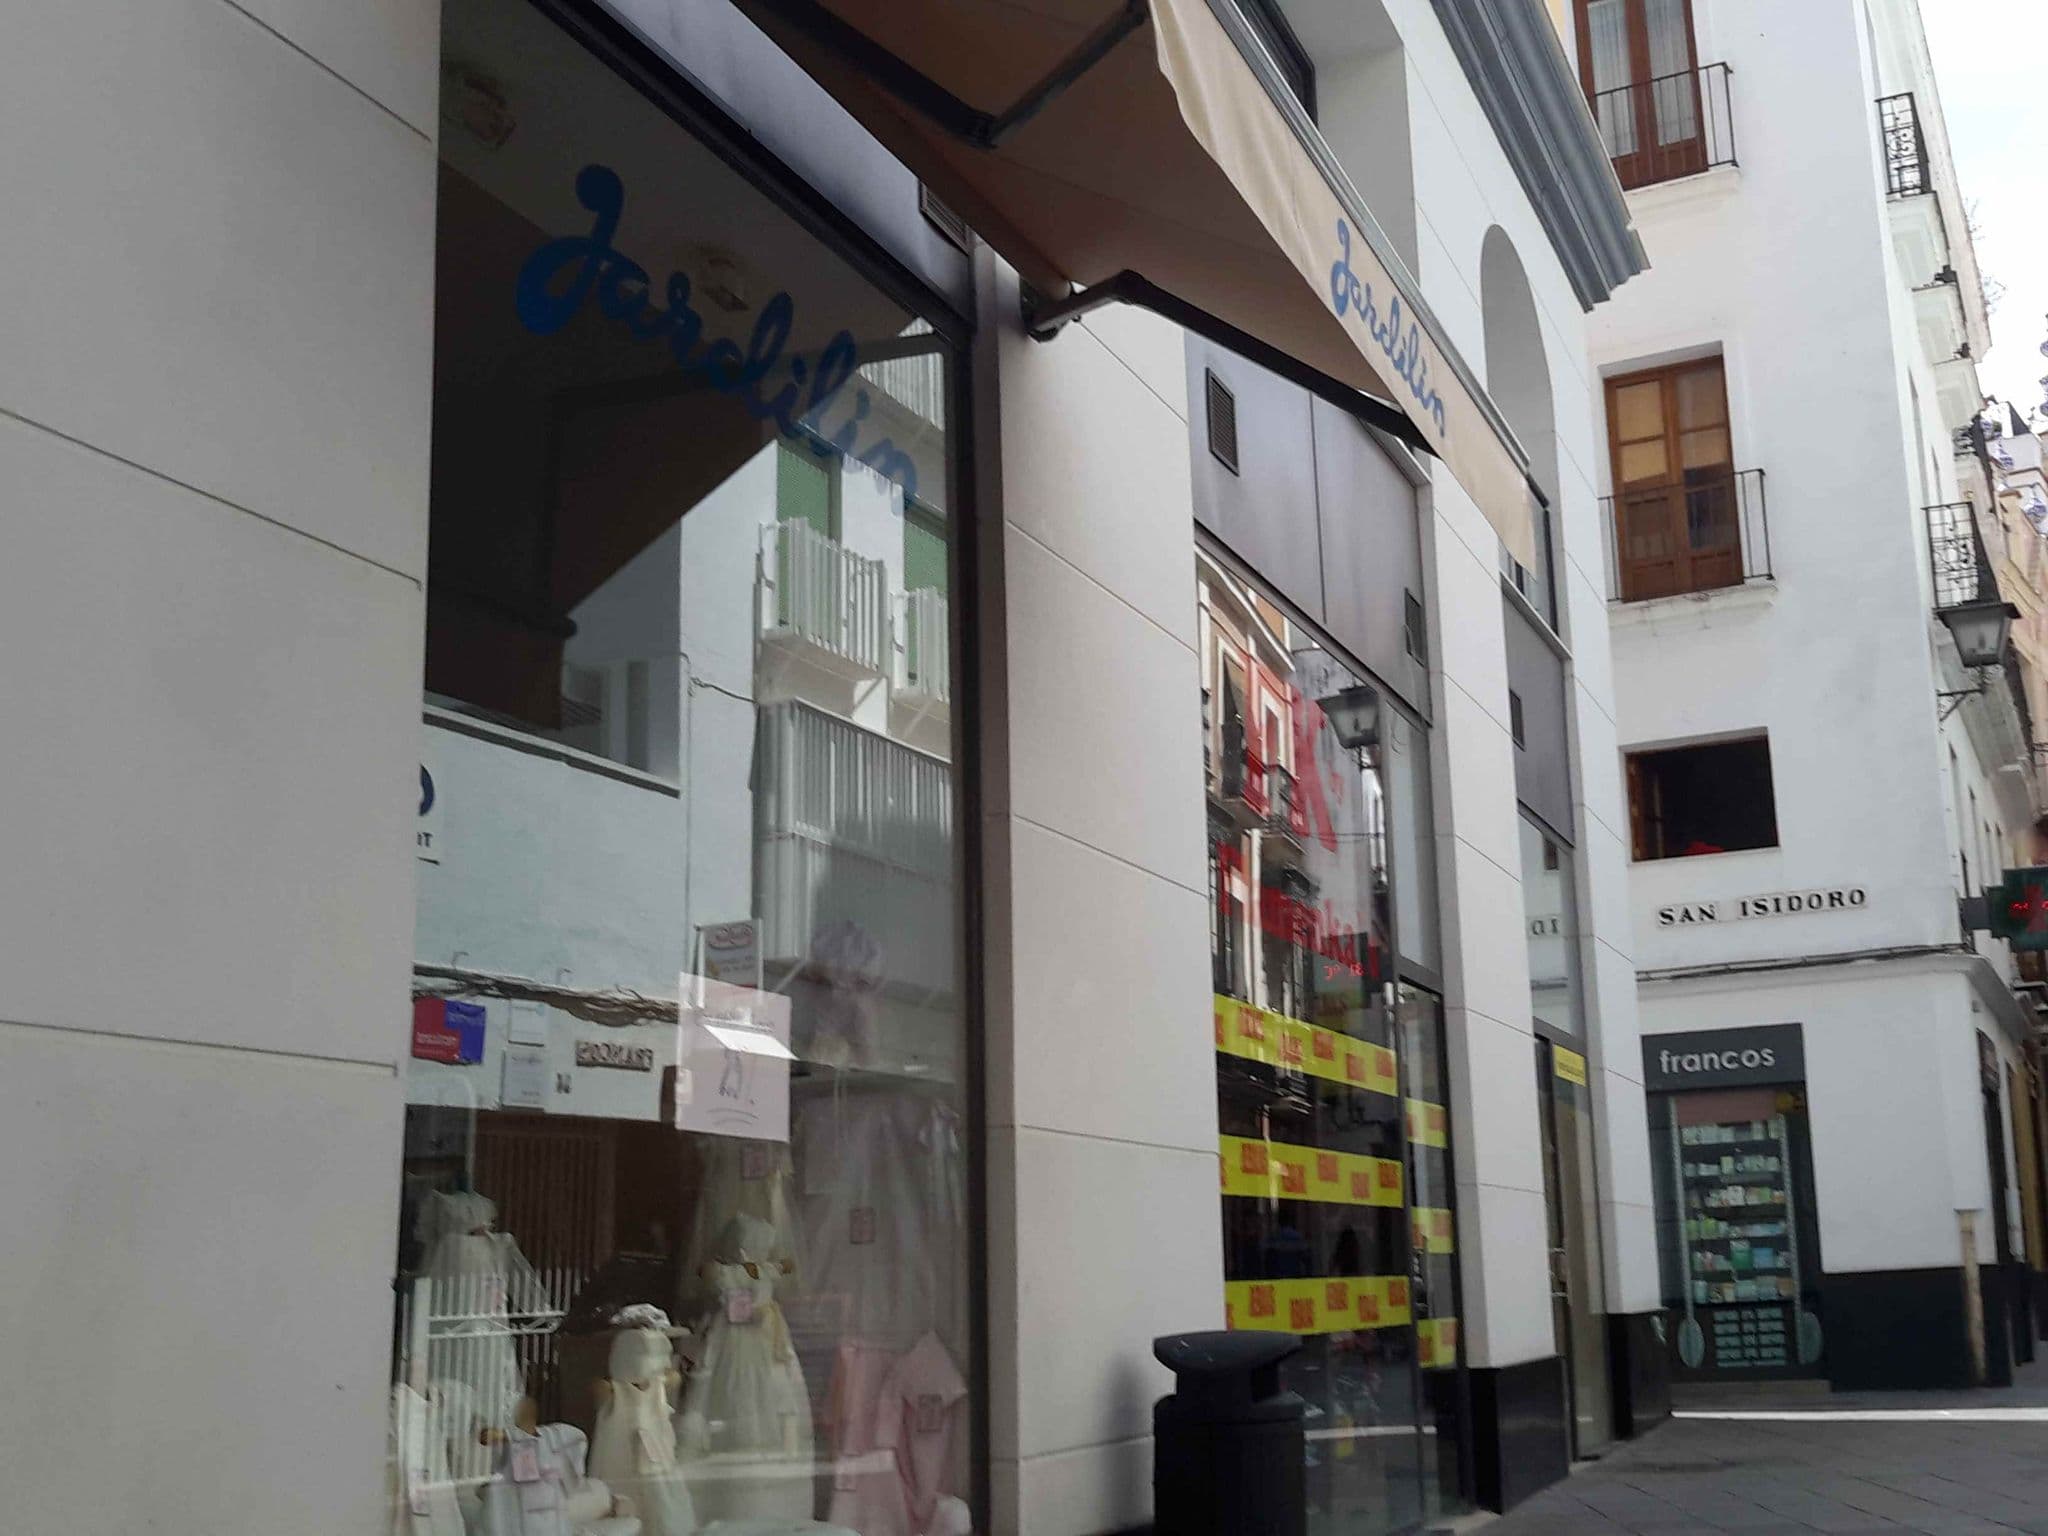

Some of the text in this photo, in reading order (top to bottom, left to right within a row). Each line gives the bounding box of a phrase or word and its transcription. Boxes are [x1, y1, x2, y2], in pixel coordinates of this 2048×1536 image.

[1658, 888, 1866, 926] SAN ISIDORO
[1660, 1047, 1776, 1074] francos
